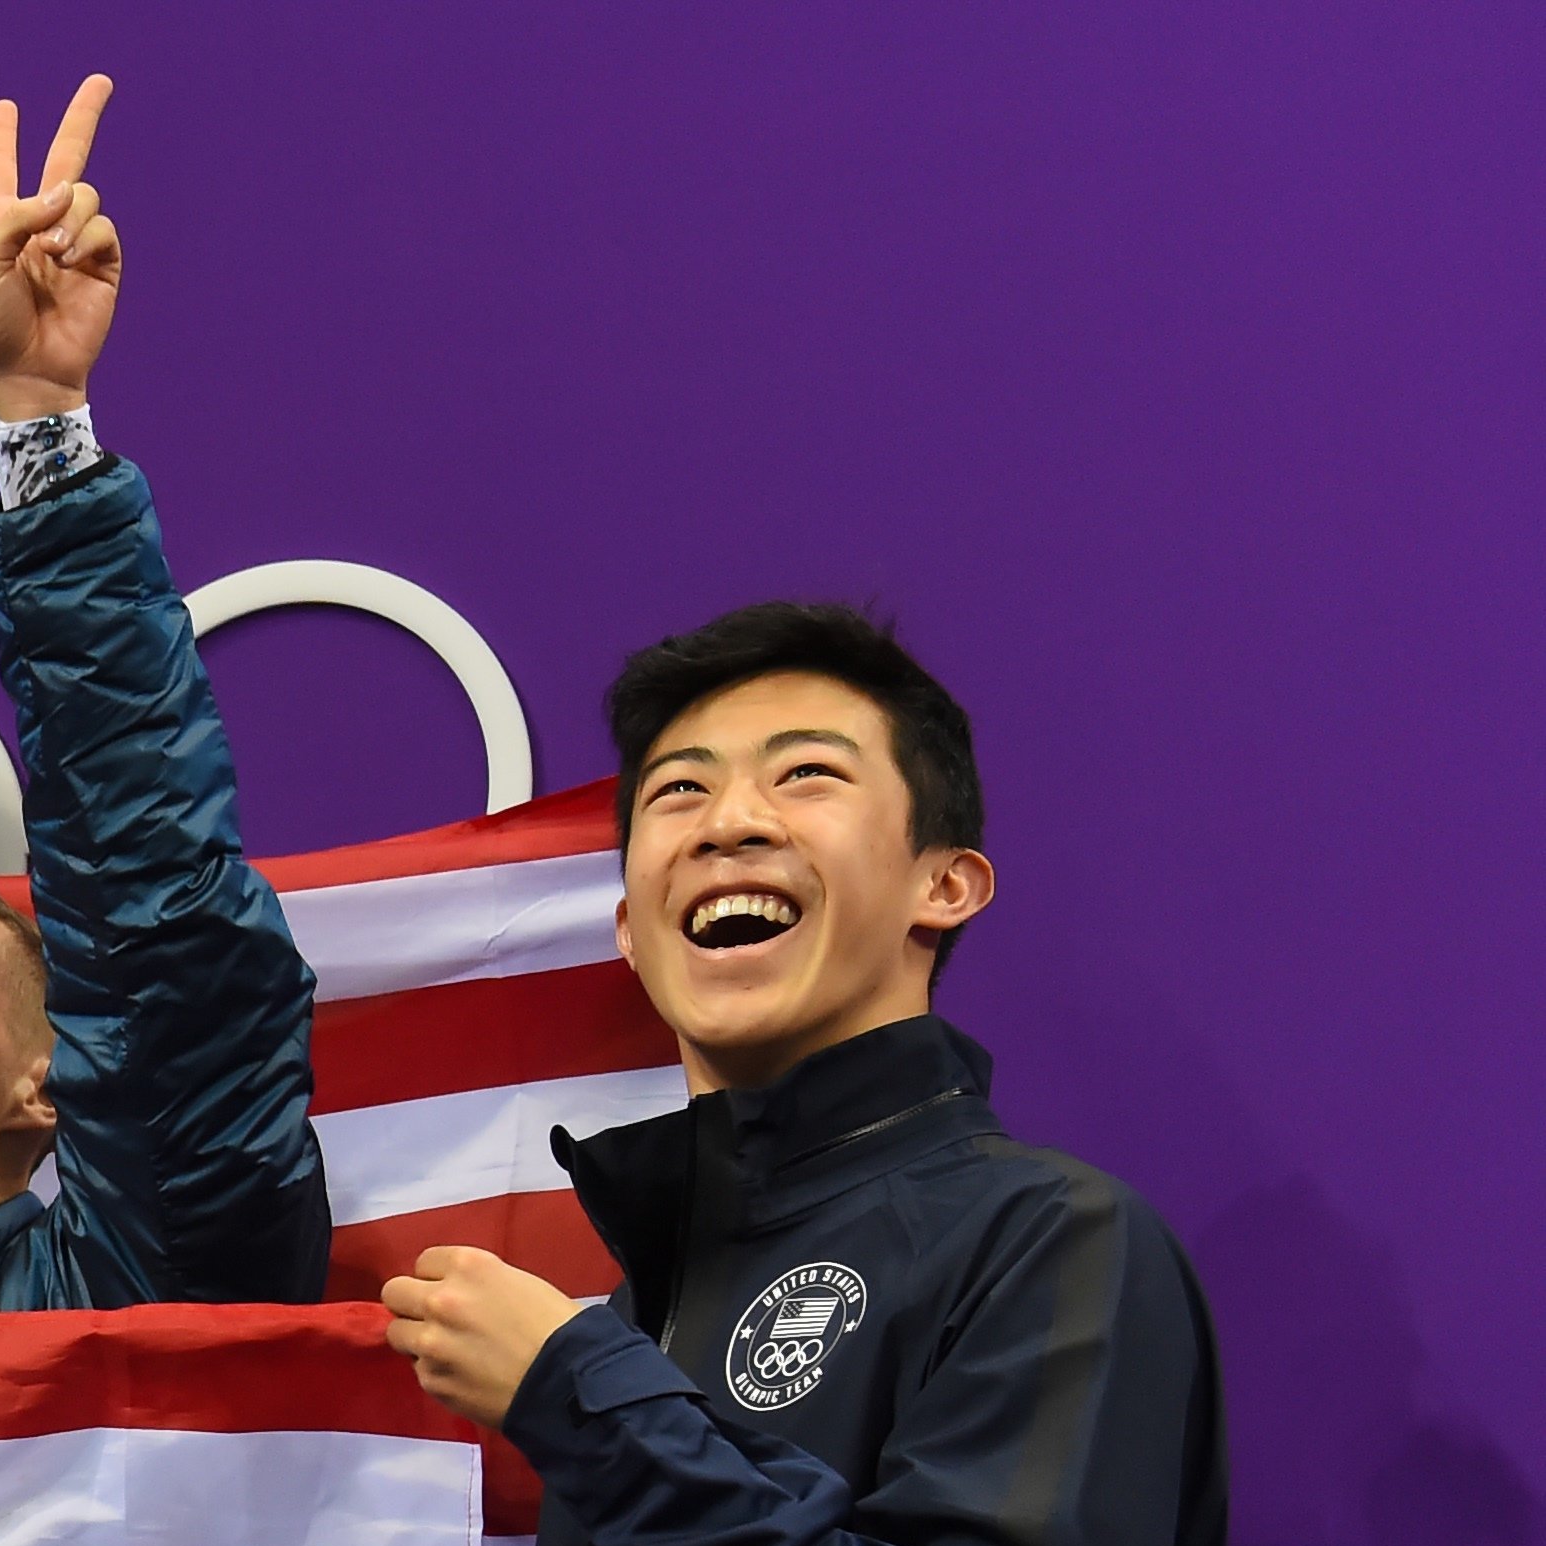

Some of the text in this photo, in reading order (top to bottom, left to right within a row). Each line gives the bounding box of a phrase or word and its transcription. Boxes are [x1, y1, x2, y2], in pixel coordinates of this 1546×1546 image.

[762, 1268, 861, 1307] UNITED STATES
[735, 1366, 824, 1405] OLYMPIC TEAM
